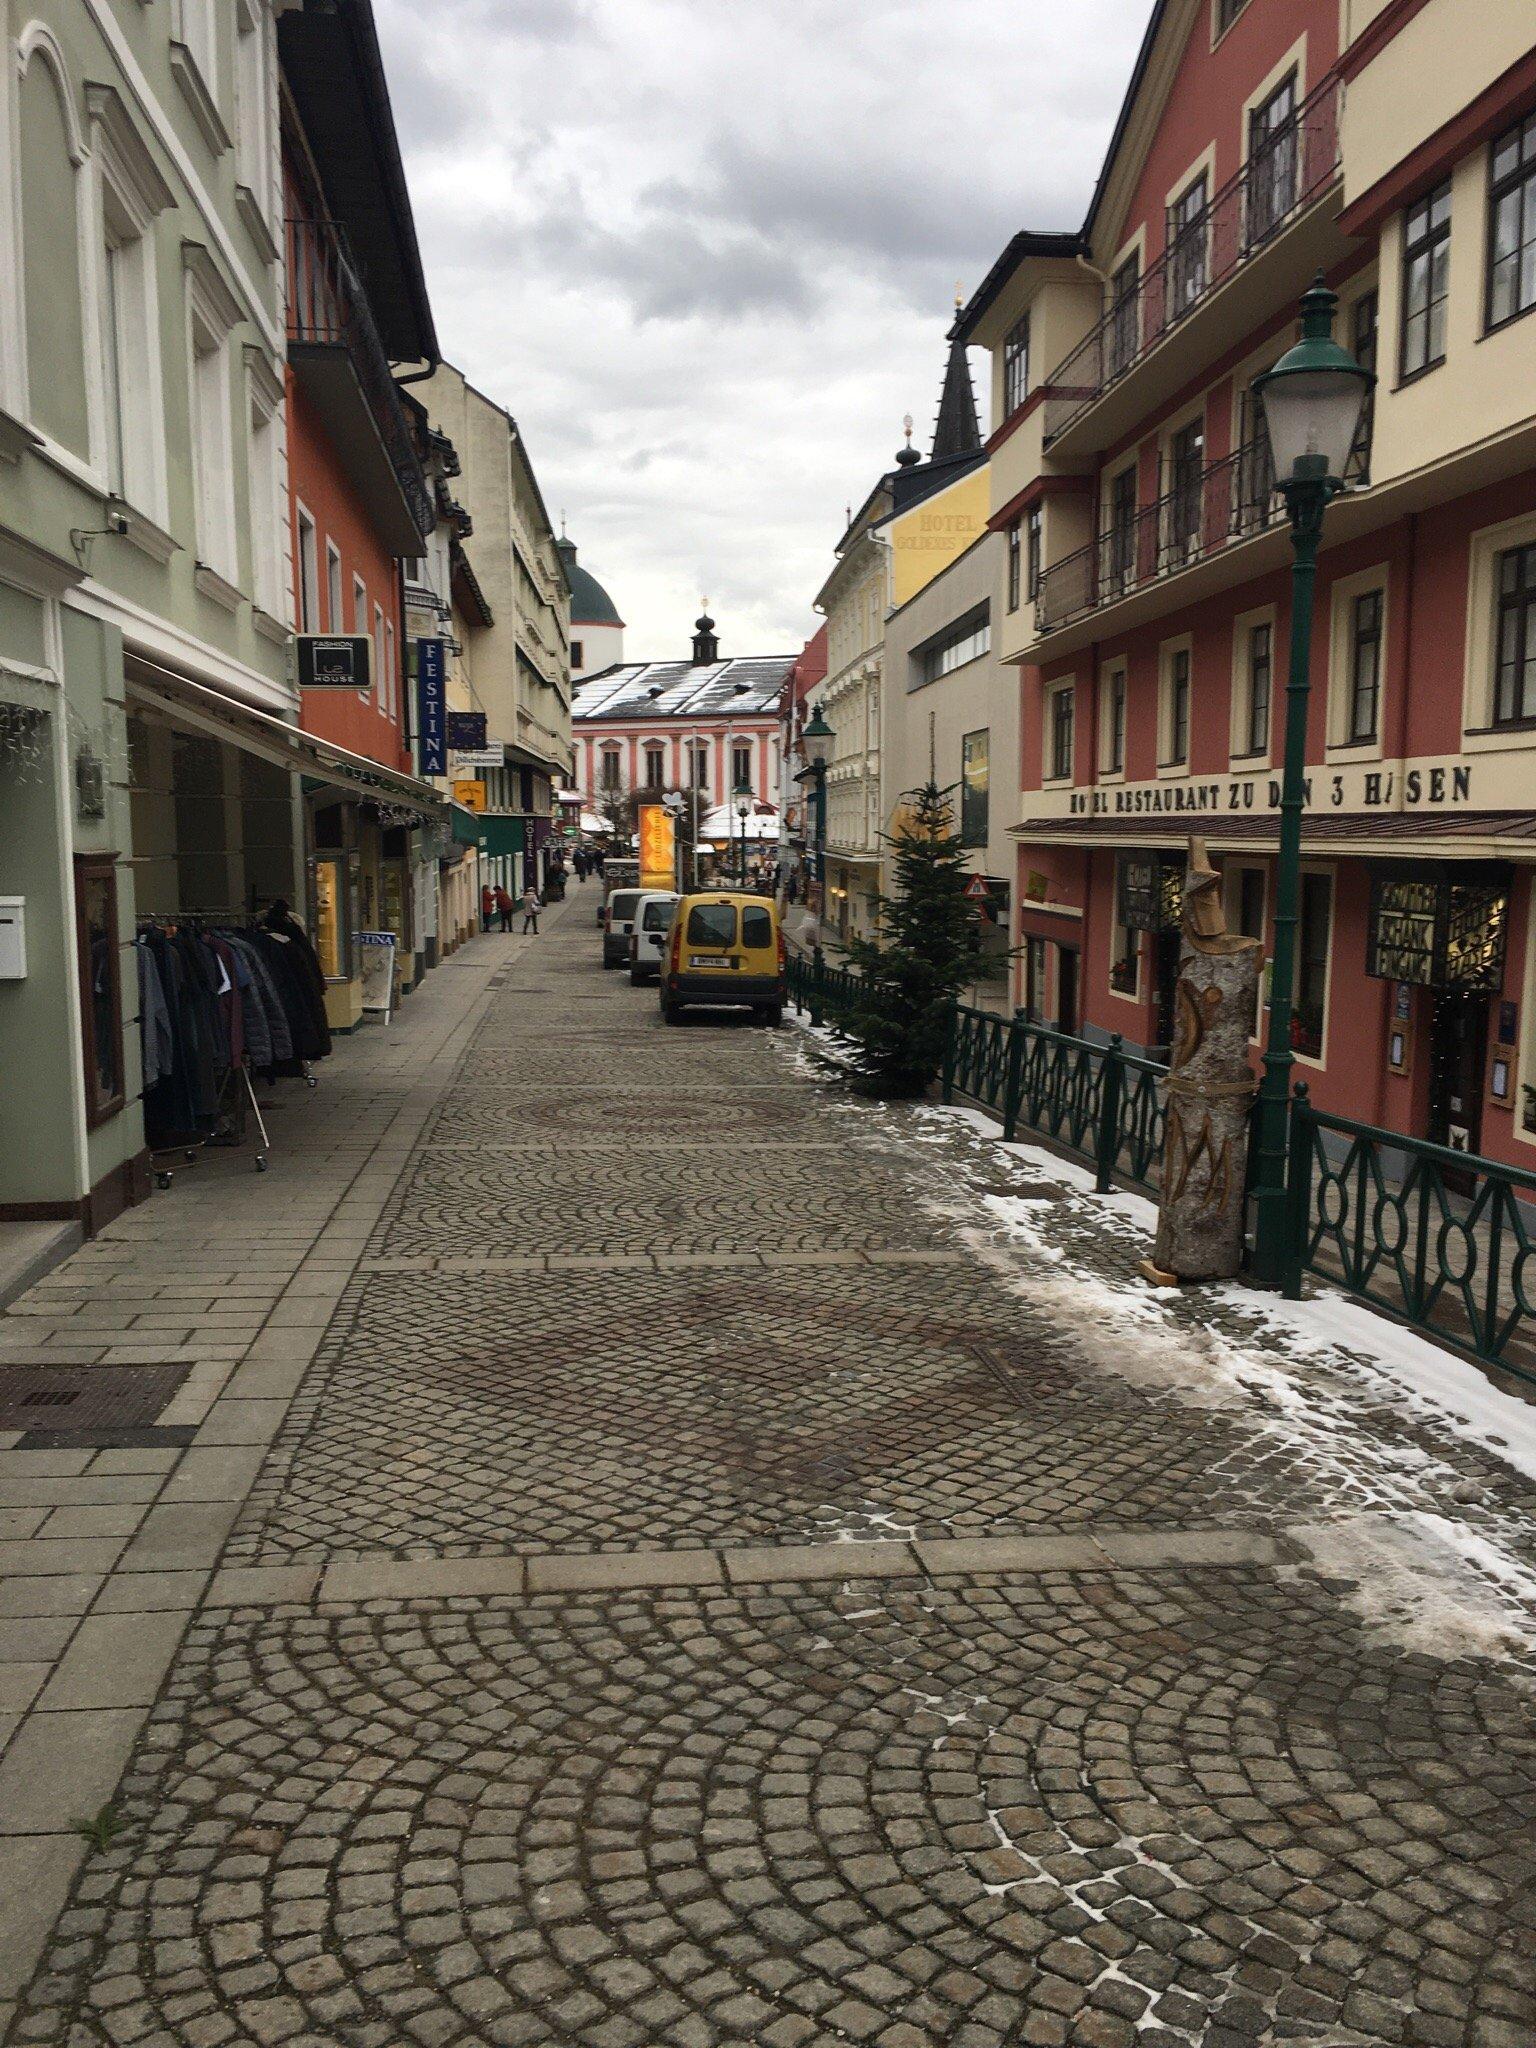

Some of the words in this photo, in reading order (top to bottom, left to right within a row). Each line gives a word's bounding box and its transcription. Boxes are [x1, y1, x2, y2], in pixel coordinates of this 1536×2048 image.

[919, 514, 977, 532] HOTEL
[312, 640, 354, 648] FASHION
[313, 675, 355, 683] HOUSE
[425, 643, 442, 771] FESTINA
[1069, 791, 1108, 813] HOEL
[1115, 784, 1220, 813] RESTAURANT
[1228, 782, 1254, 809] ZU
[1267, 777, 1313, 808] DN
[1332, 775, 1344, 807] 3
[525, 819, 535, 858] HOTEL
